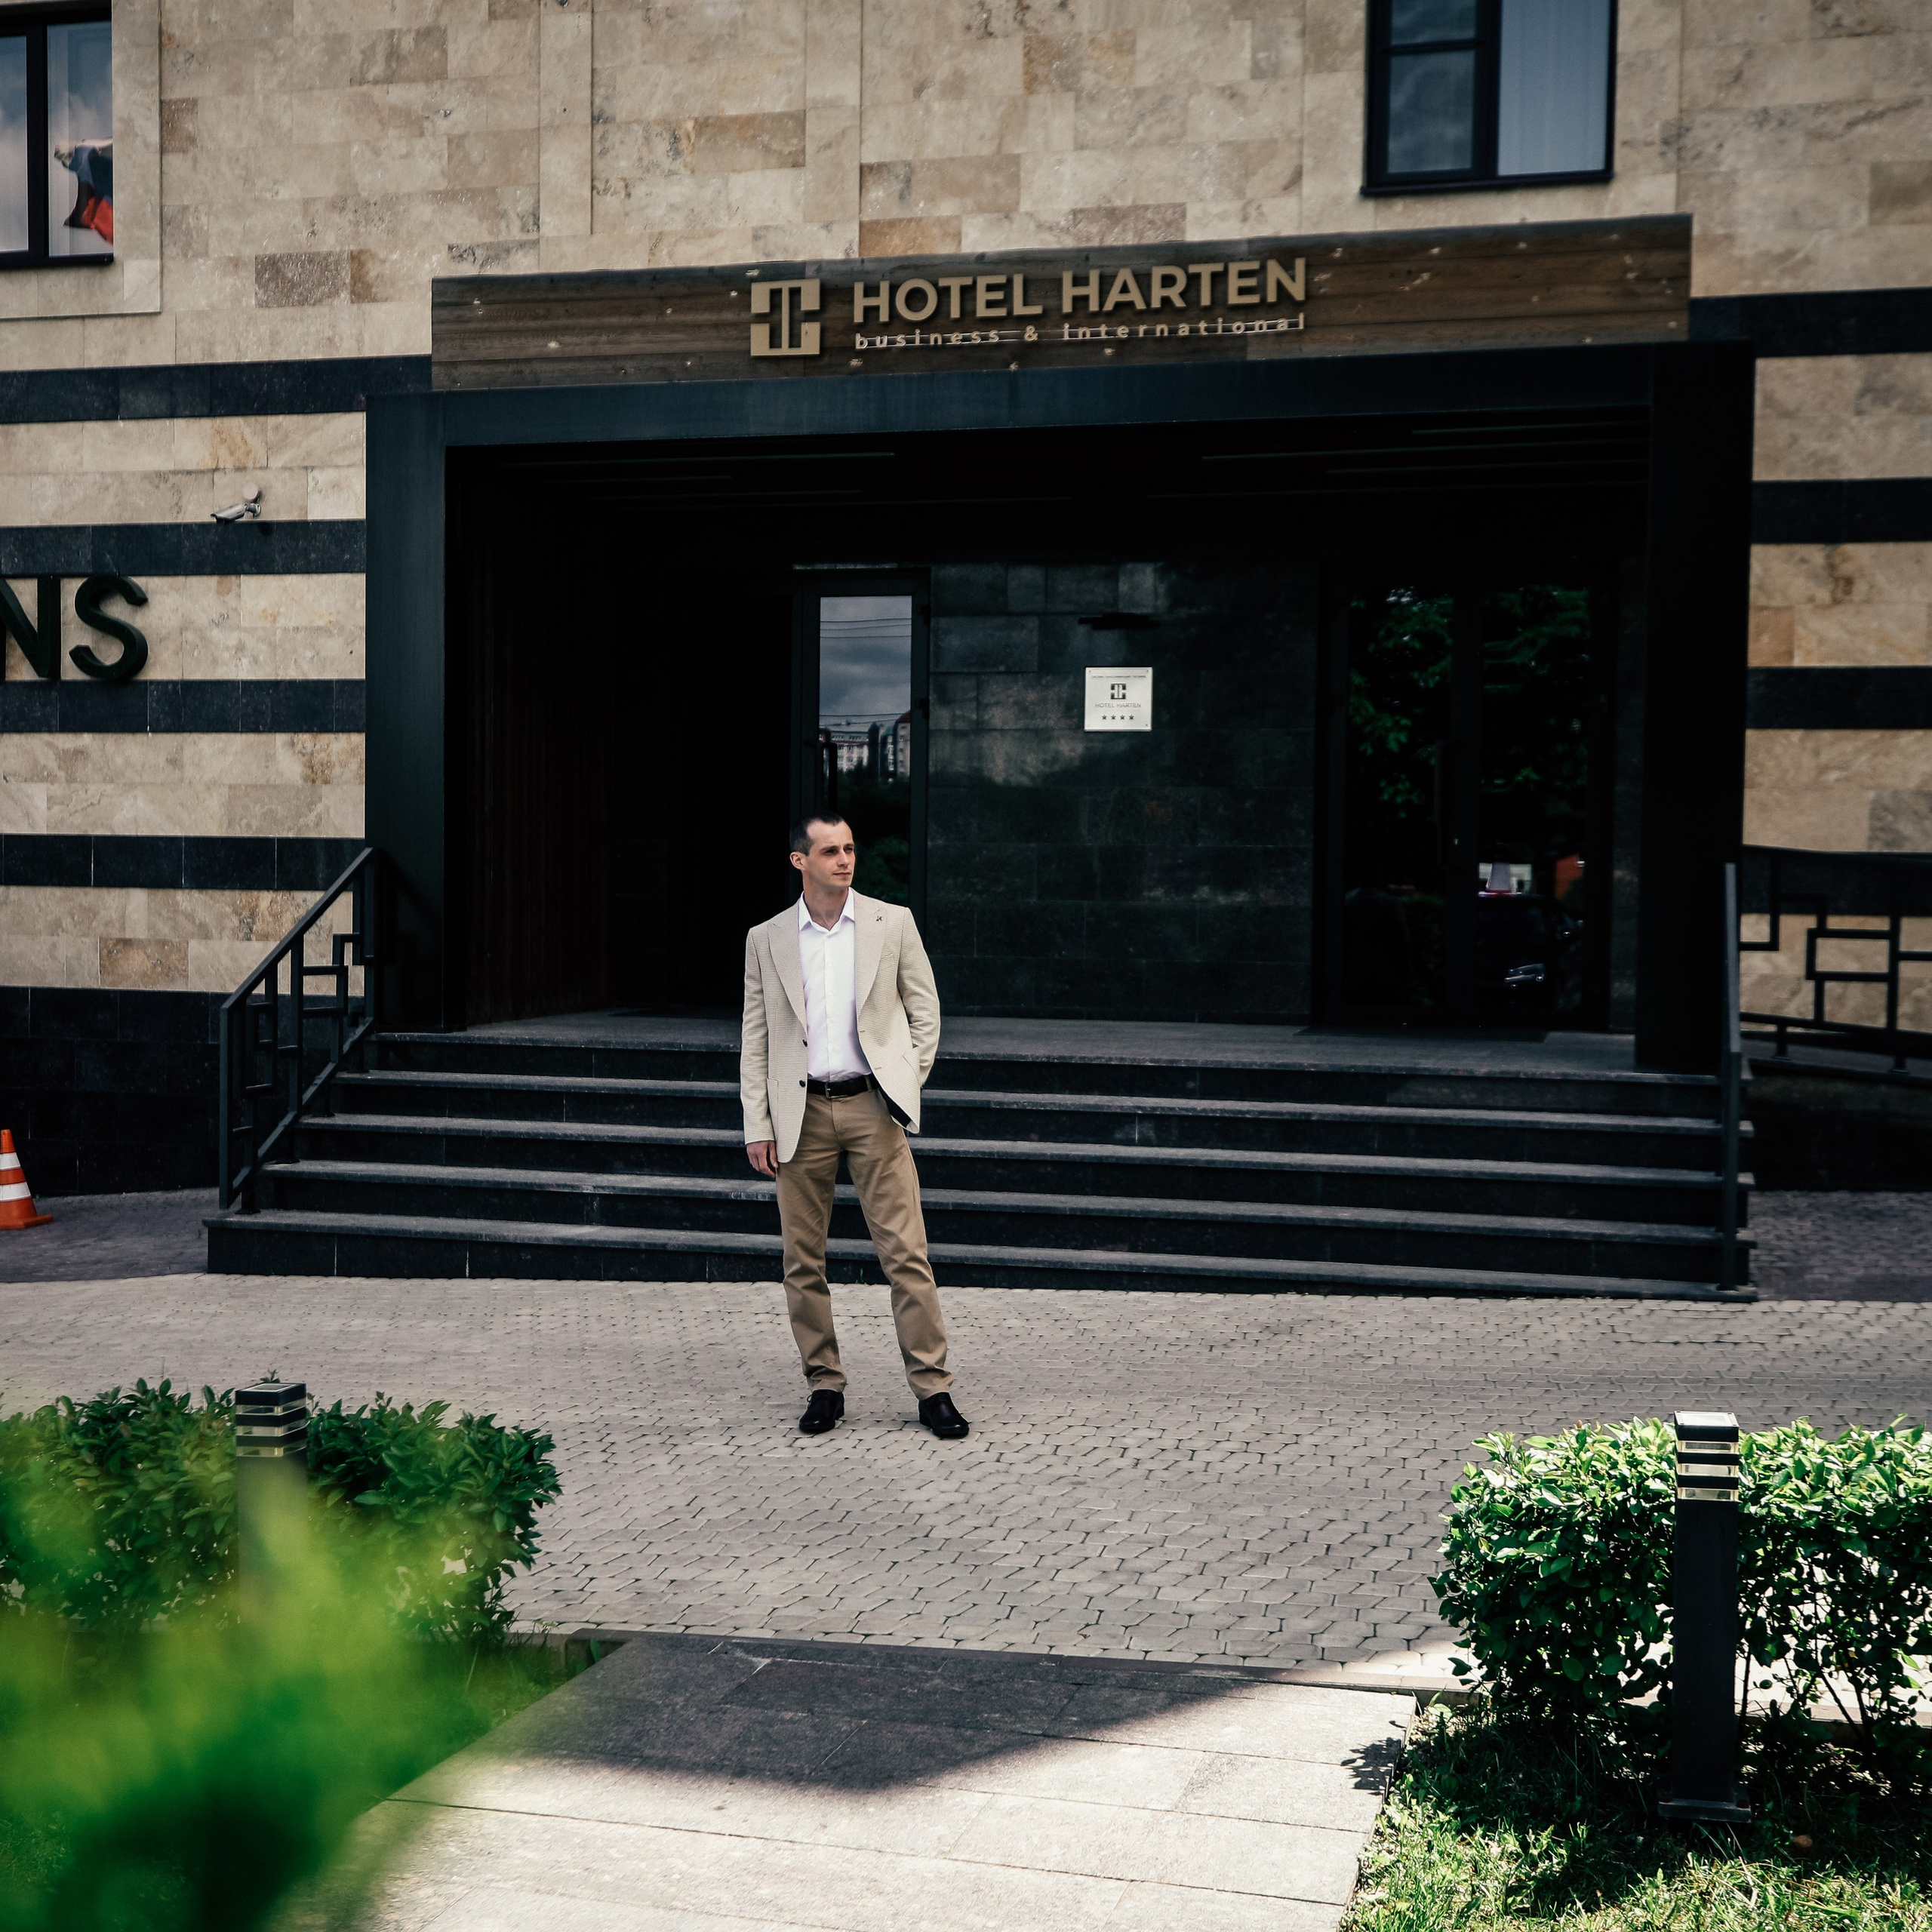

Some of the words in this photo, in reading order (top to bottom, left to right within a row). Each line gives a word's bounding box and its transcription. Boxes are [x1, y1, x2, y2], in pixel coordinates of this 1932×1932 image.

[854, 274, 1043, 323] HOTEL
[1061, 257, 1306, 313] HARTEN
[855, 328, 999, 349] business
[1023, 325, 1038, 342] &
[1063, 312, 1304, 340] international
